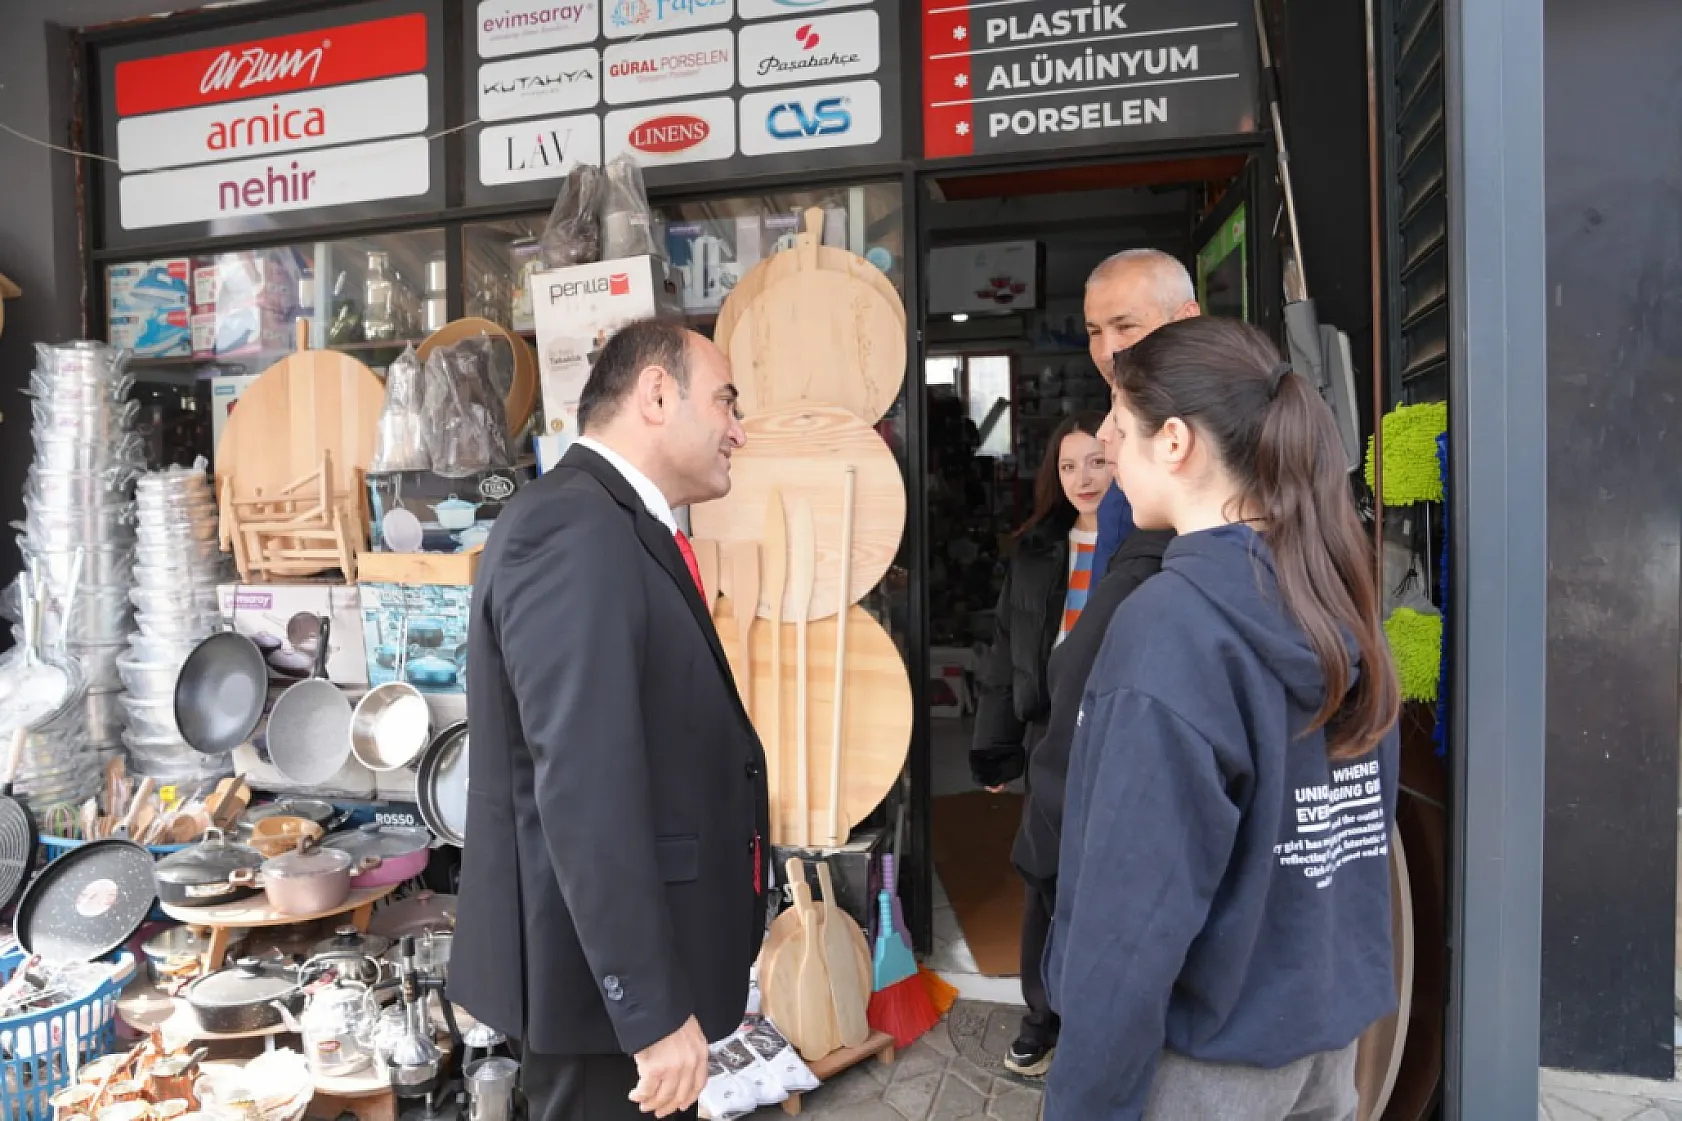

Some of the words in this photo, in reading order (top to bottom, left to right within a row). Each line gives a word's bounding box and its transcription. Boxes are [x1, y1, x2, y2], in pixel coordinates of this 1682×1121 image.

[483, 3, 586, 32] evimsaray
[986, 0, 1127, 43] PLASTİK
[609, 58, 658, 77] GÜRAL
[661, 49, 728, 70] PORSELEN
[986, 45, 1199, 91] ALÜMİNYUM
[206, 103, 326, 151] arnica
[634, 122, 705, 147] LINENS
[766, 97, 852, 139] CVS
[989, 97, 1168, 137] PORSELEN
[219, 161, 316, 210] nehir
[550, 277, 609, 305] perilla
[375, 813, 415, 825] ROSSO
